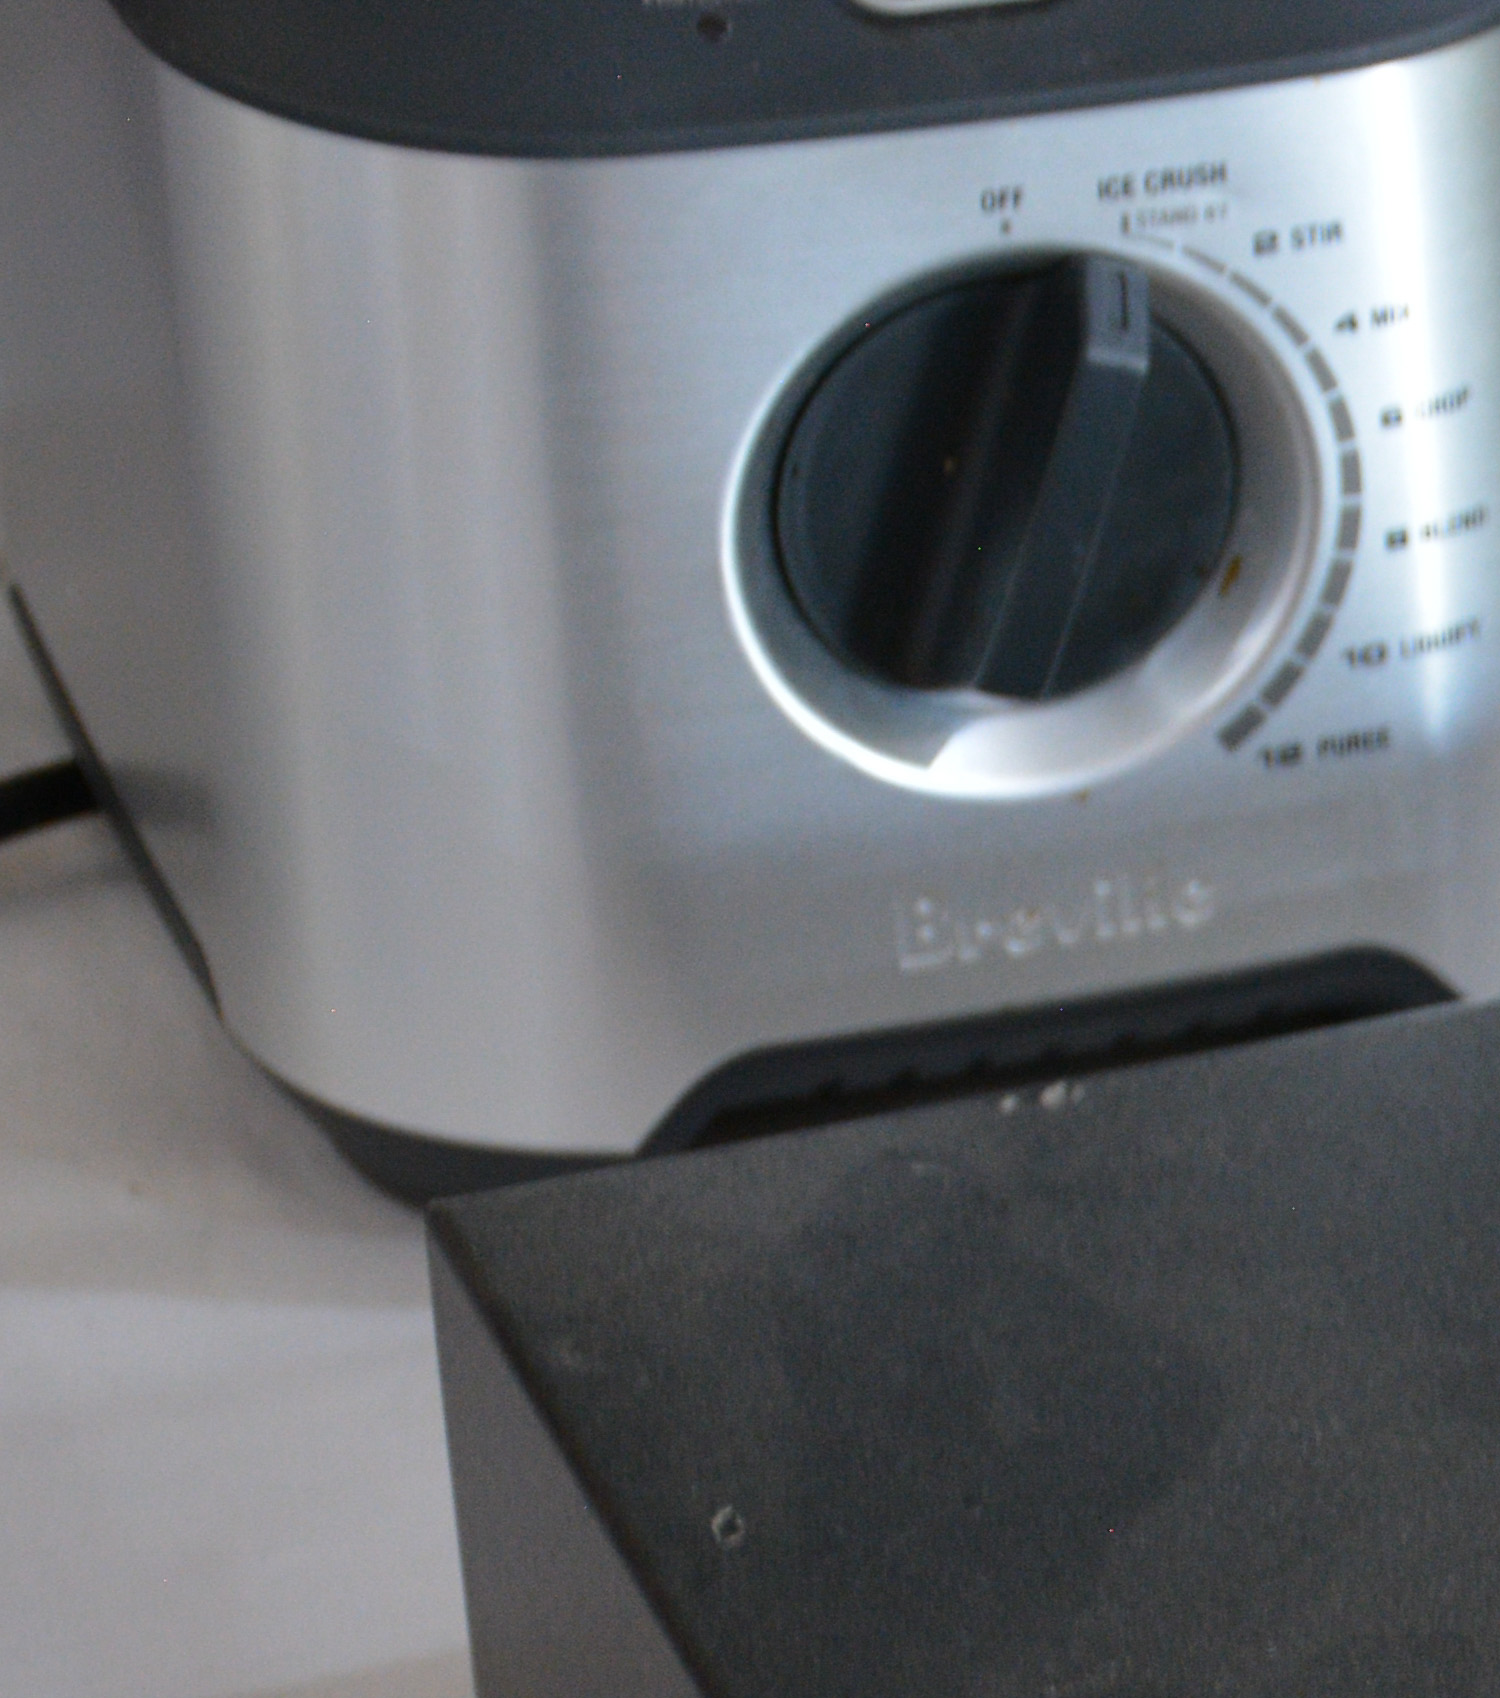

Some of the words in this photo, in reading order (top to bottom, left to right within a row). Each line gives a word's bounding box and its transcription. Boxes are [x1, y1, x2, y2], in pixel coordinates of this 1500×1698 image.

[1098, 174, 1135, 200] ICE
[1144, 162, 1228, 194] CRUSH
[980, 184, 1024, 212] OFF
[1290, 222, 1342, 249] STIR
[897, 876, 1216, 968] Breville
